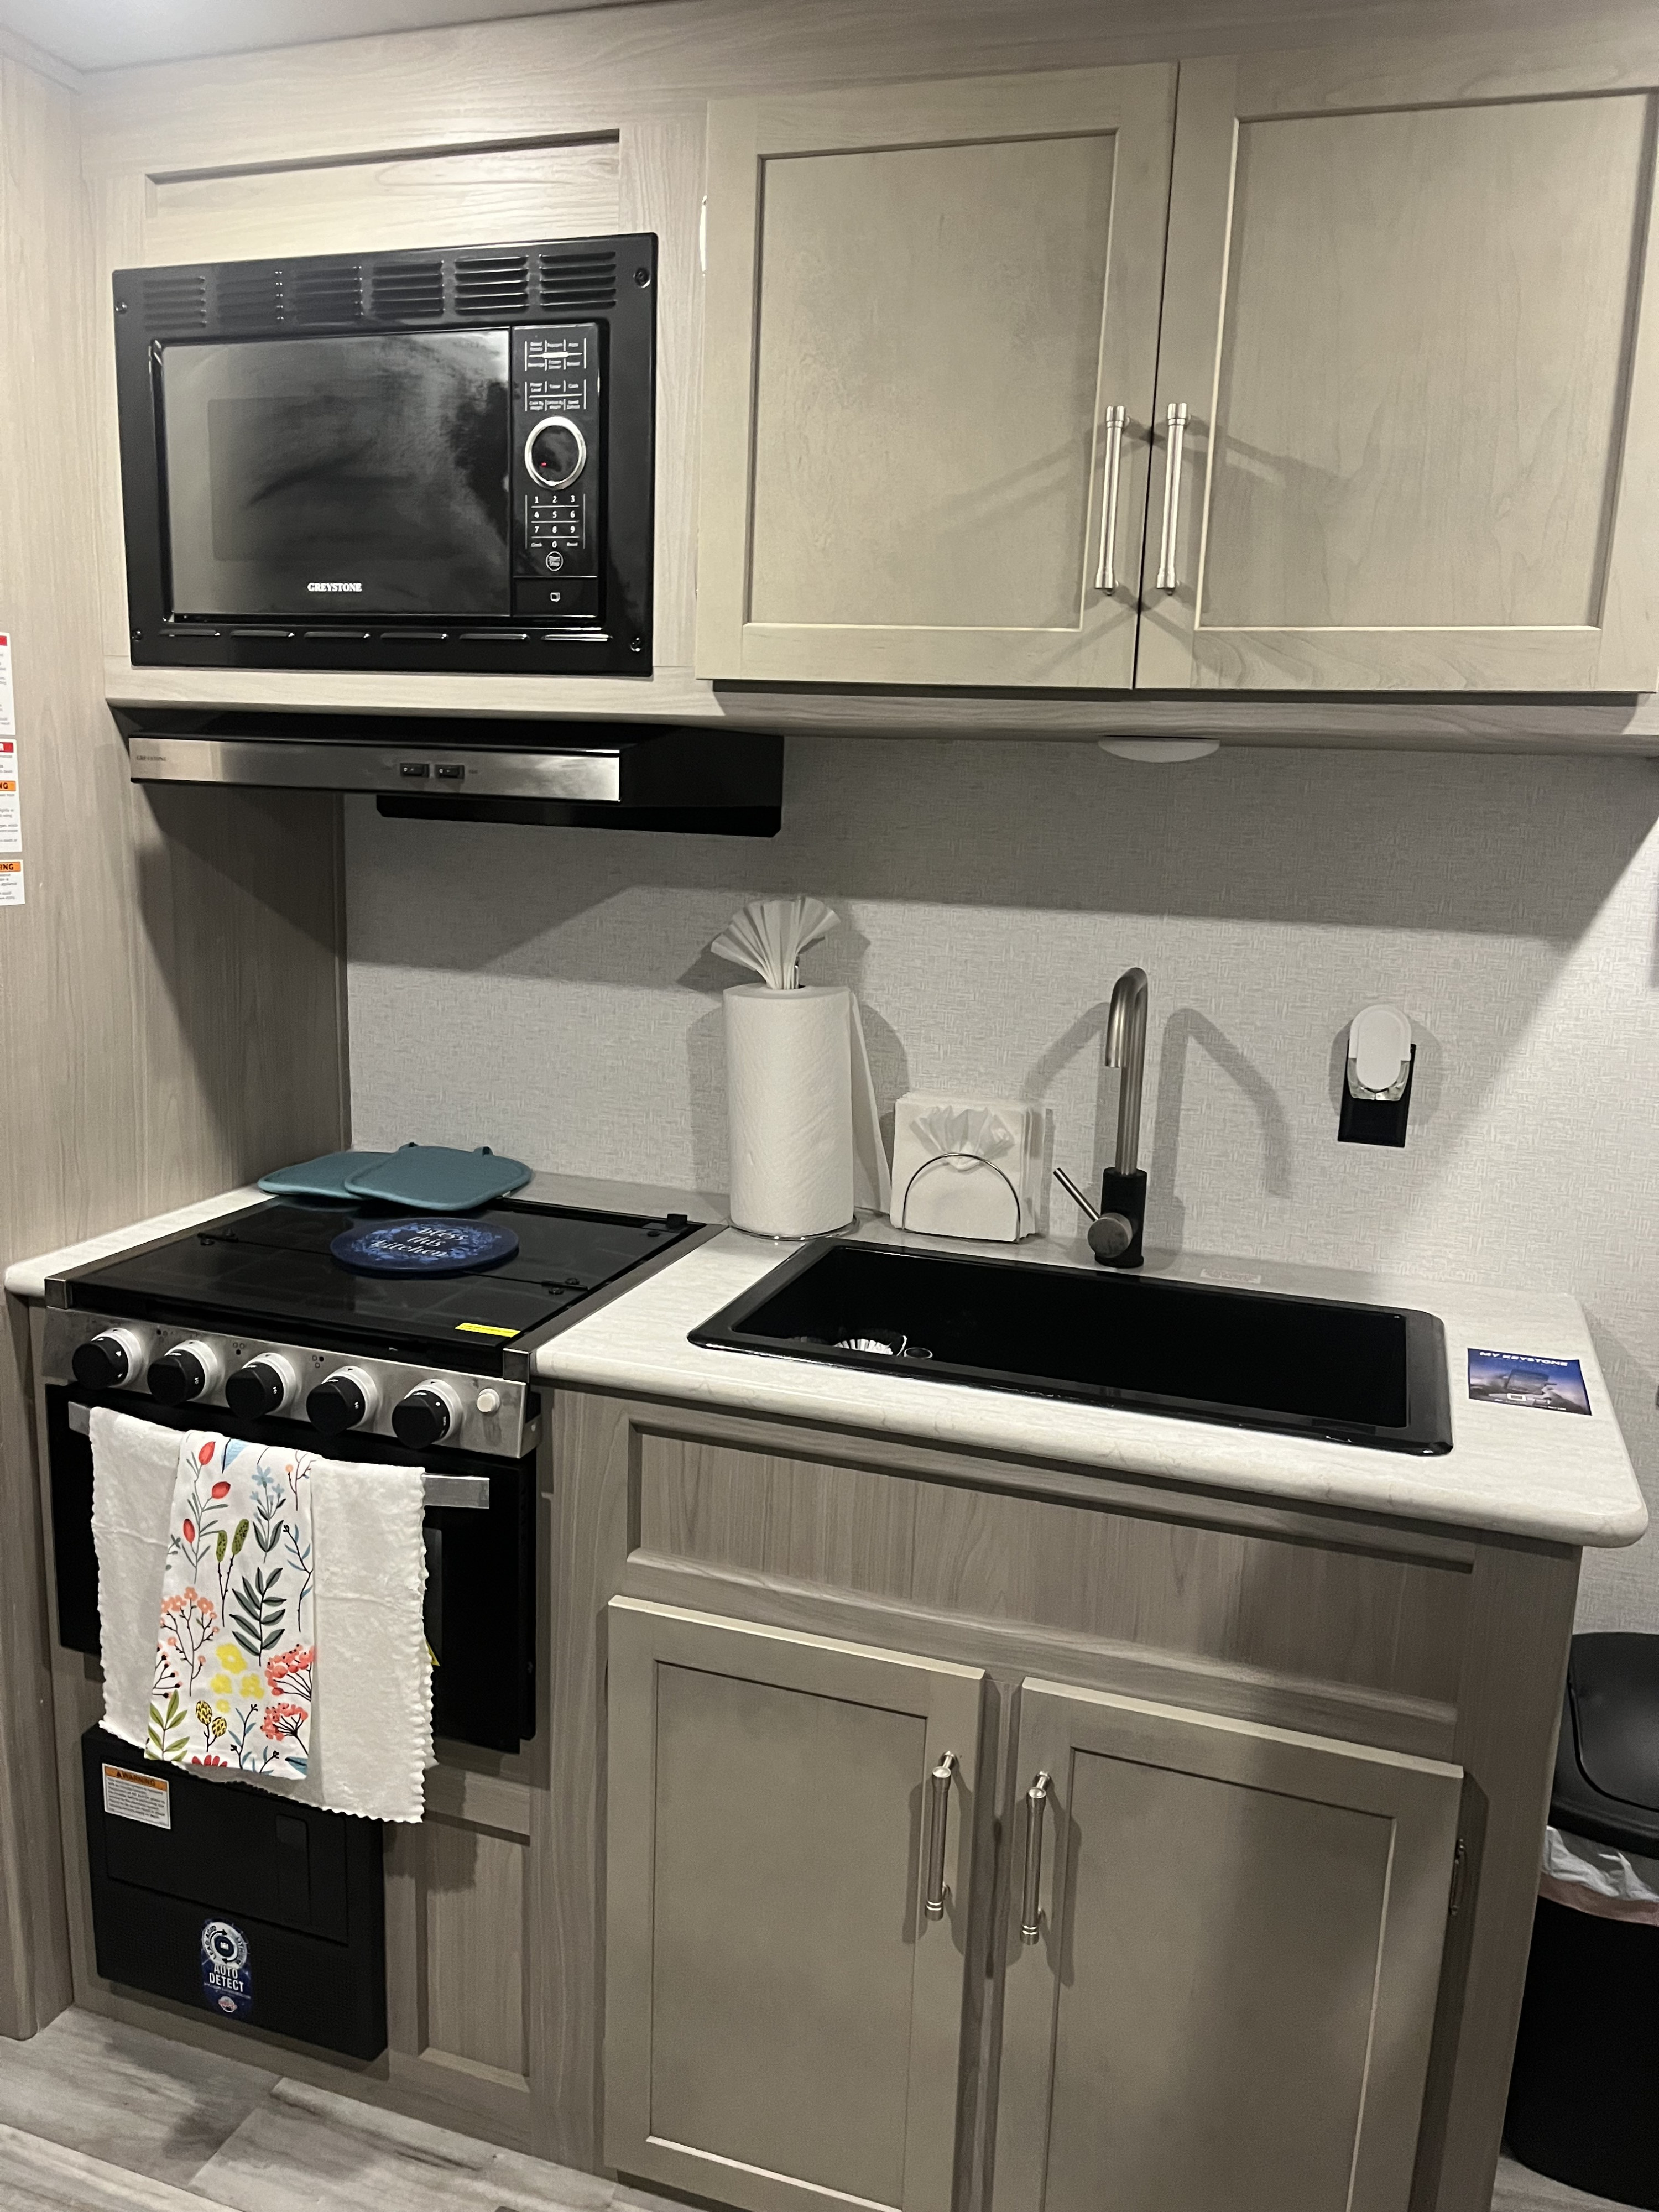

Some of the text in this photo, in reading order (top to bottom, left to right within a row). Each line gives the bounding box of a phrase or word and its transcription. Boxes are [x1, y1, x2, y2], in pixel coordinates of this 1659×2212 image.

[307, 583, 362, 592] GREYSTONE
[1502, 1354, 1568, 1366] KEYSTONE
[214, 1965, 238, 1979] AUTO
[209, 1972, 244, 1992] DETECT
